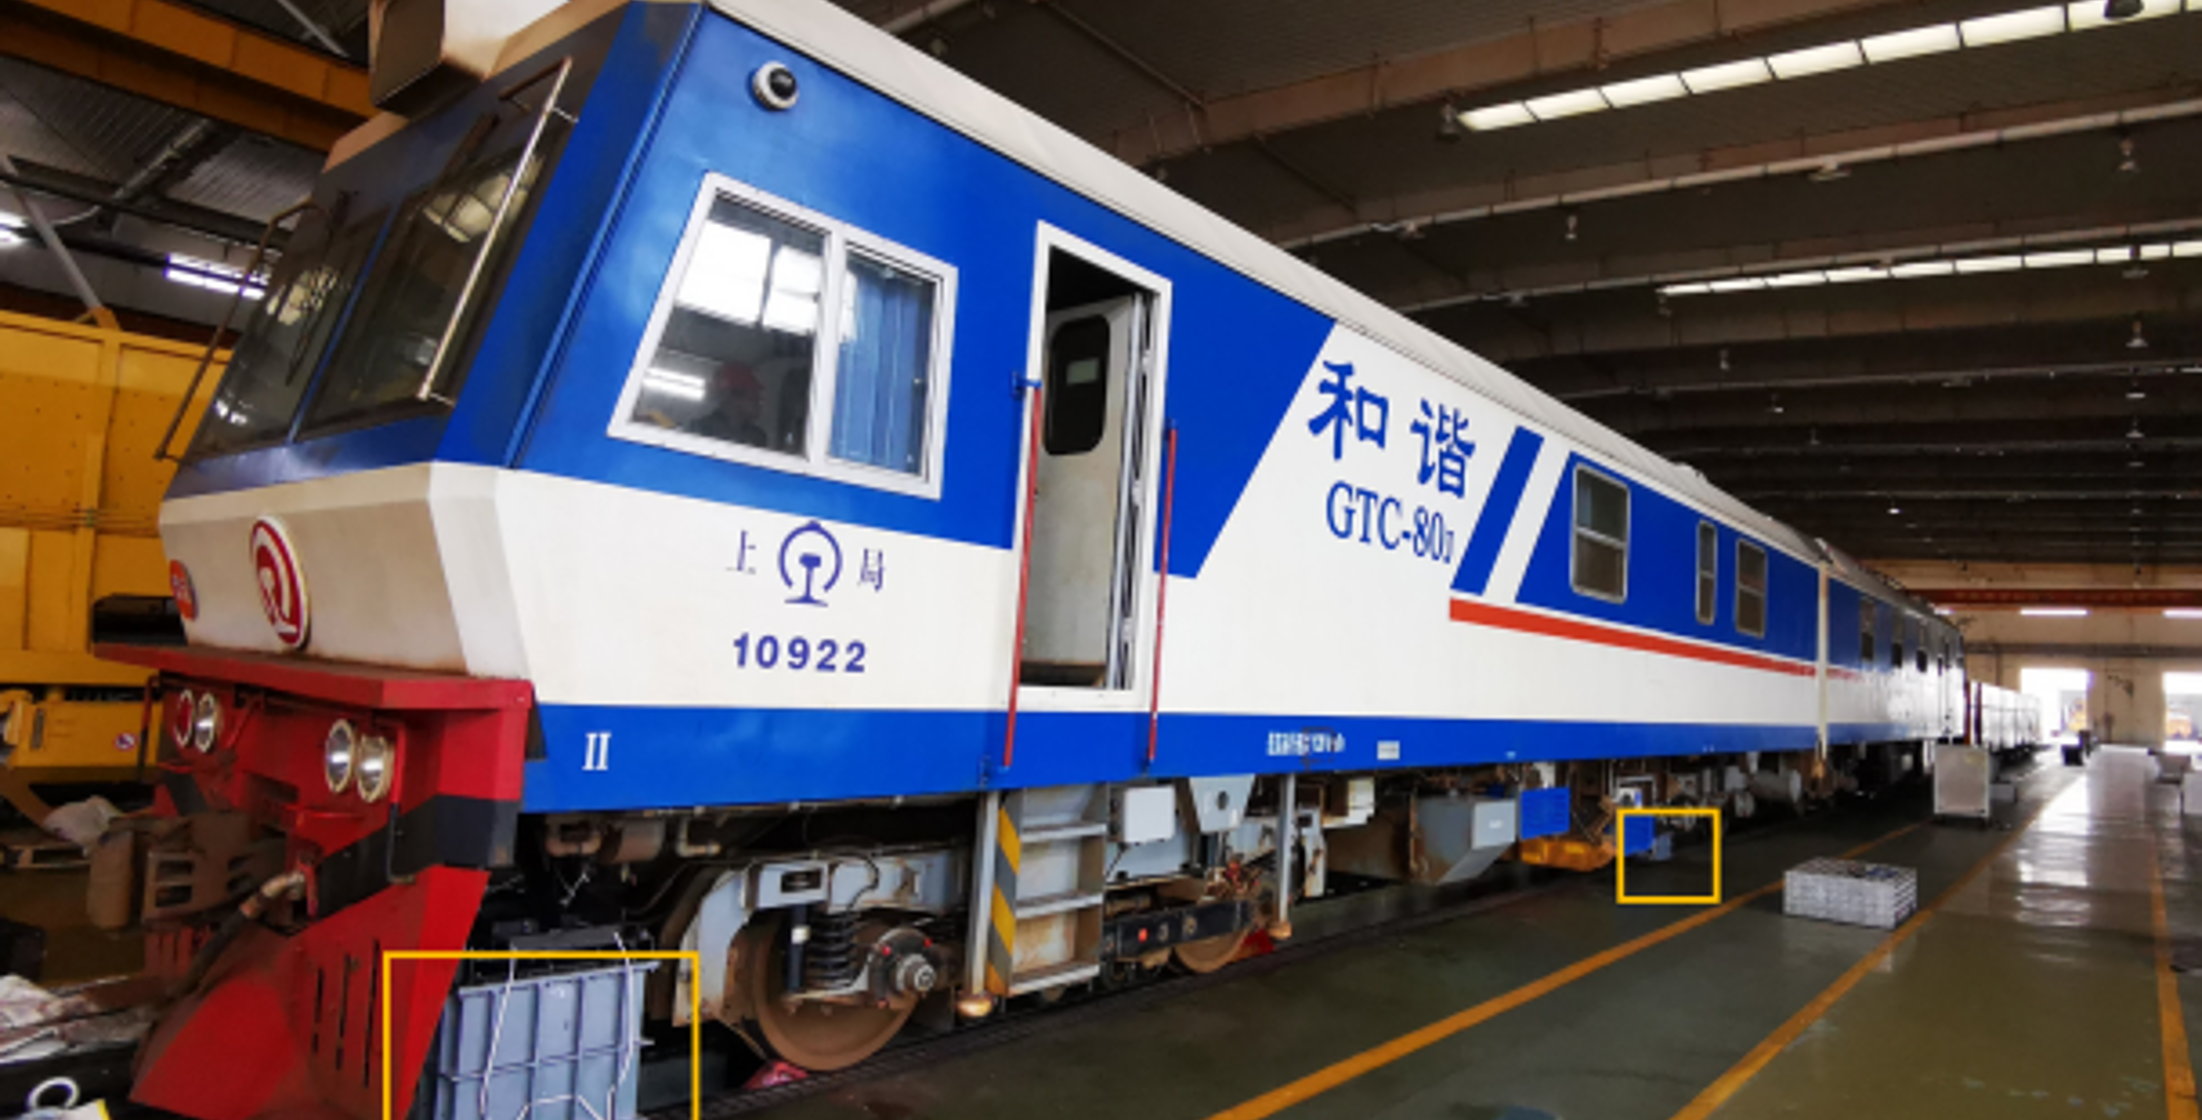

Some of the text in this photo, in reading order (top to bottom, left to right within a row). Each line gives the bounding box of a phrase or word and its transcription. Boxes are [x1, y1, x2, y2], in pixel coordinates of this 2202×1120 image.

[1307, 360, 1476, 499] 和谐
[857, 547, 885, 592] 局
[733, 632, 867, 673] 10922
